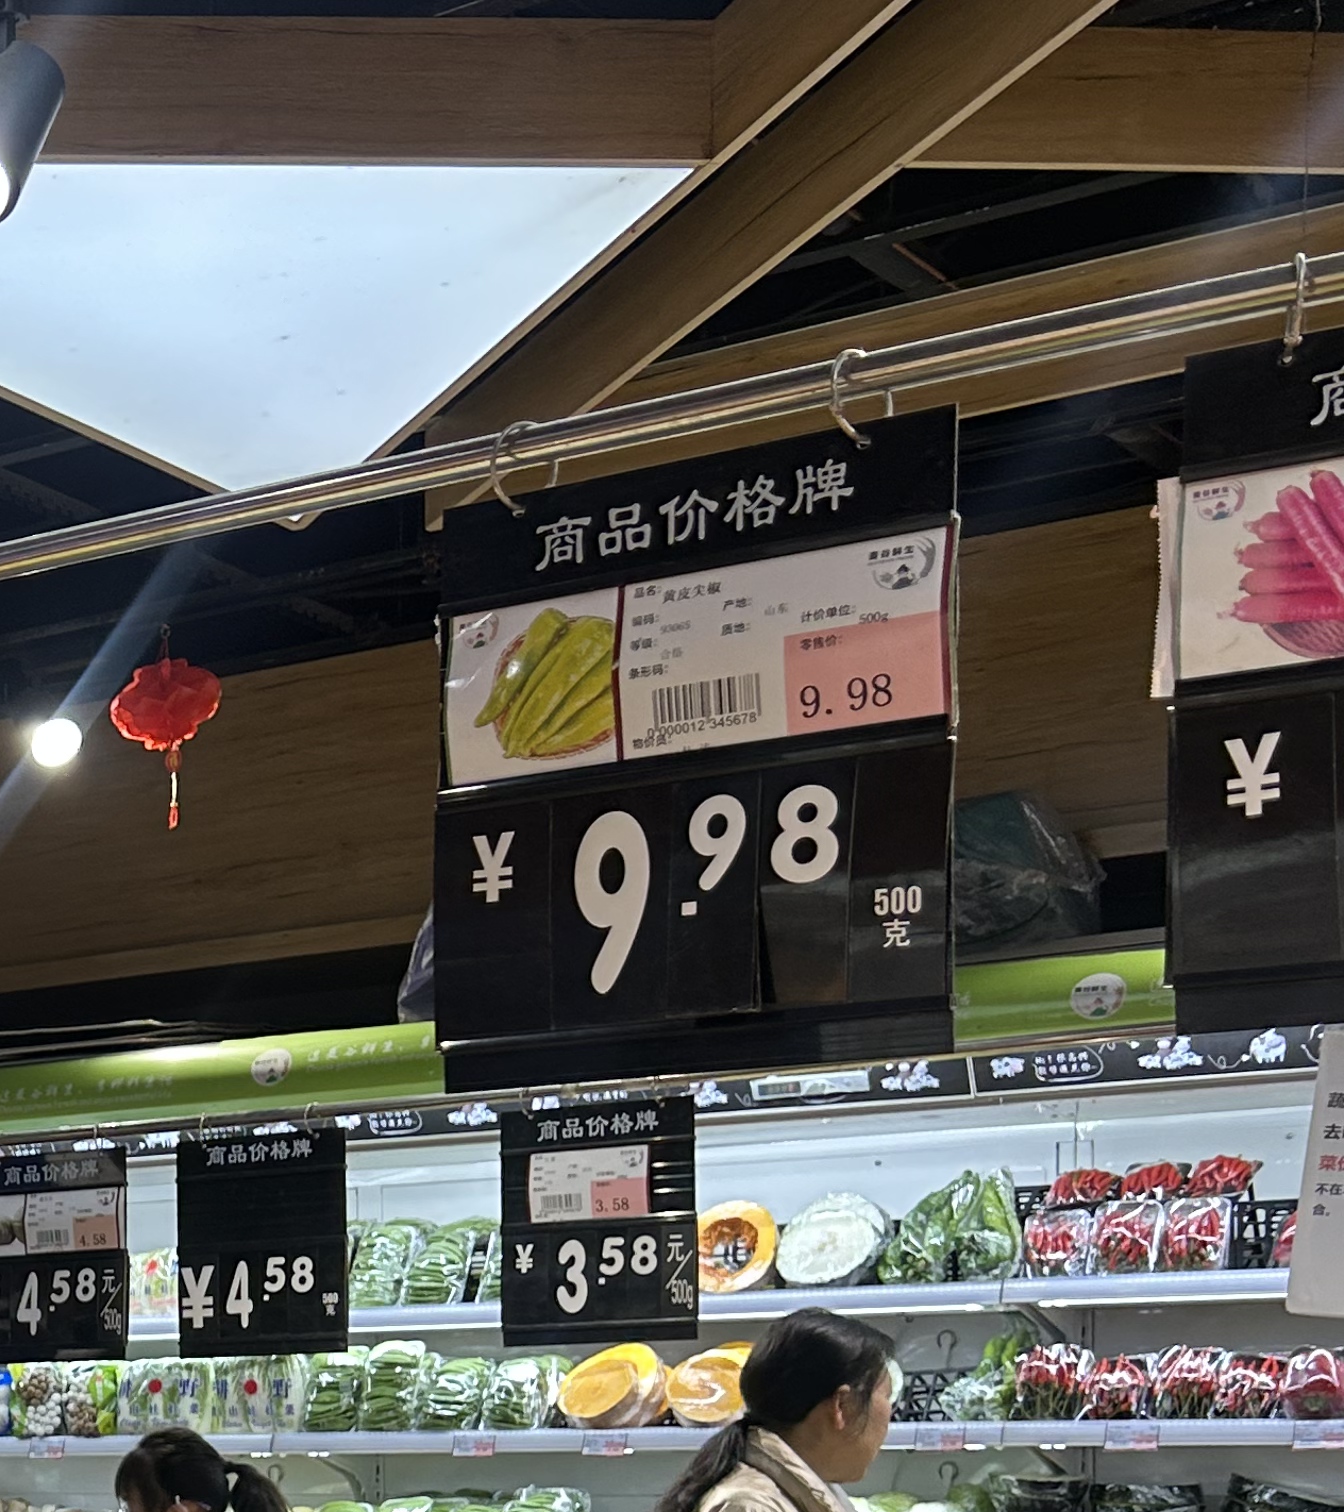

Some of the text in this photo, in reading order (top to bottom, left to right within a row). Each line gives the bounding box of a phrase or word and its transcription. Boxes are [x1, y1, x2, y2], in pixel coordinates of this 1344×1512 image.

[535, 458, 855, 573] 商品价格牌
[798, 672, 893, 719] 9.98
[1223, 730, 1281, 818] ¥
[472, 784, 840, 994] ¥ 9.98
[873, 885, 923, 915] 500
[882, 919, 910, 949] 克
[537, 1109, 659, 1143] 商品价格牌
[206, 1136, 313, 1166] 商品价格牌
[3, 1159, 99, 1187] 商品价格牌
[595, 1196, 630, 1214] 3.58
[79, 1233, 108, 1248] 4.58
[180, 1255, 316, 1329] ¥ 4.58
[514, 1243, 535, 1274] ¥
[556, 1235, 658, 1314] 3.58
[16, 1267, 97, 1337] 4.58
